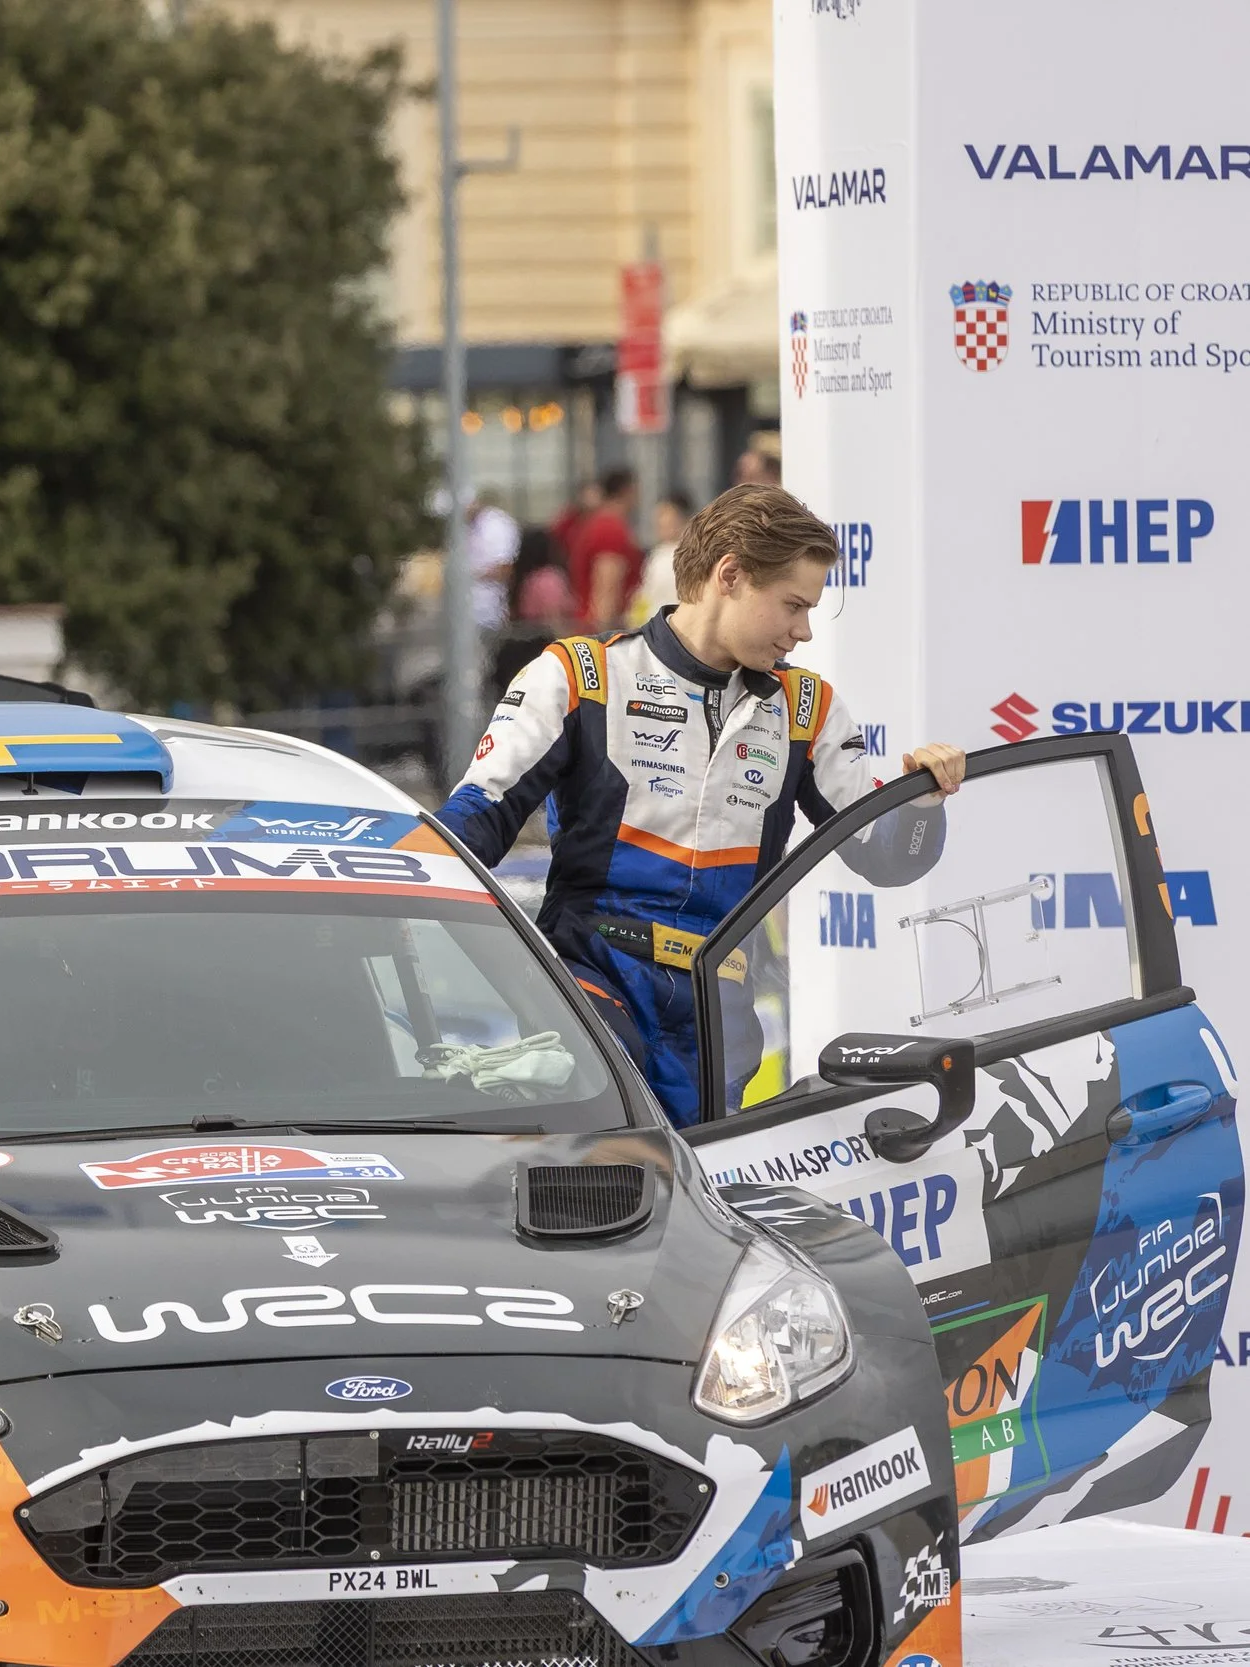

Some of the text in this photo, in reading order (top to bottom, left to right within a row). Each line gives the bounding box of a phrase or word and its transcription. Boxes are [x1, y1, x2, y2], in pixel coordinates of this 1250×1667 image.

[964, 144, 1250, 180] VALAMAR
[793, 168, 886, 210] VALAMAR
[1032, 283, 1139, 301] REPUBLIC
[1145, 283, 1174, 301] OF
[1032, 310, 1181, 340] Ministry of
[1032, 343, 1142, 368] Tourism
[1150, 343, 1197, 367] and
[869, 367, 892, 397] Sport
[1089, 499, 1215, 563] HEP
[574, 642, 598, 690] sparco
[636, 682, 676, 695] WRC
[797, 677, 814, 728] sparco
[1052, 700, 1250, 734] SUZUKI
[631, 759, 686, 774] HYRMASKINER
[265, 828, 340, 839] LUBRICANTS
[907, 820, 927, 856] sparco
[608, 927, 648, 940] FULL
[819, 890, 877, 948] INA
[175, 1204, 387, 1224] WRC
[181, 1193, 361, 1206] JUNIOR
[1139, 1219, 1173, 1255] FIA
[1102, 1218, 1215, 1314] JUNIOR
[89, 1284, 584, 1343] WRC2
[1095, 1245, 1228, 1368] WRC
[342, 1379, 398, 1400] Ford
[406, 1431, 494, 1453] Rally2
[328, 1569, 438, 1592] PX24 BWL
[923, 1573, 941, 1597] M
[924, 1598, 951, 1608] POLAND
